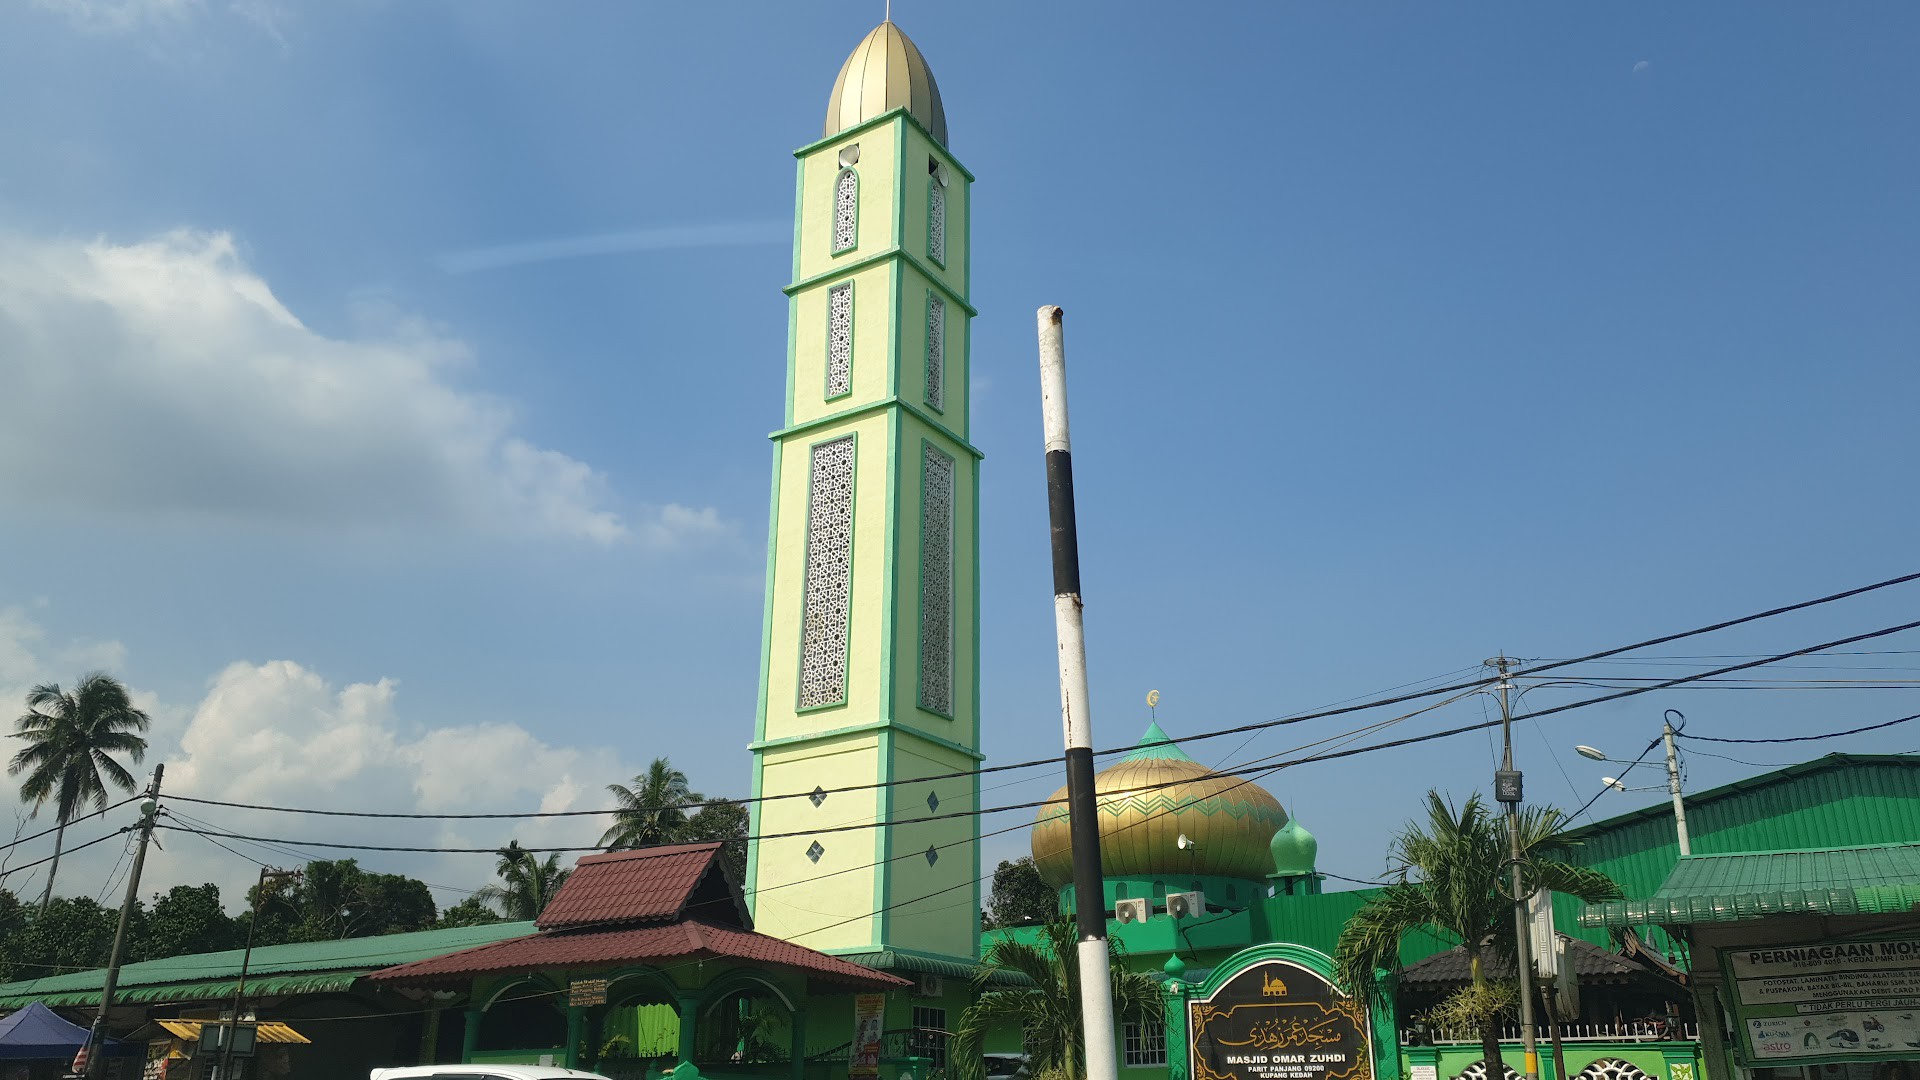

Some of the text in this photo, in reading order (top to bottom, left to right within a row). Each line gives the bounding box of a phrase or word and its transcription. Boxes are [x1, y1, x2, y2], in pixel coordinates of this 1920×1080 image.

[1750, 943, 1875, 965] PERNIAGAAN
[1875, 954, 1895, 962] PMR
[1809, 1003, 1833, 1011] TIDAK
[1835, 1001, 1863, 1009] PERLU
[1864, 999, 1891, 1007] PERGI
[1763, 1042, 1792, 1051] astro
[1226, 1053, 1346, 1065] MASJID OMAR ZUHDI
